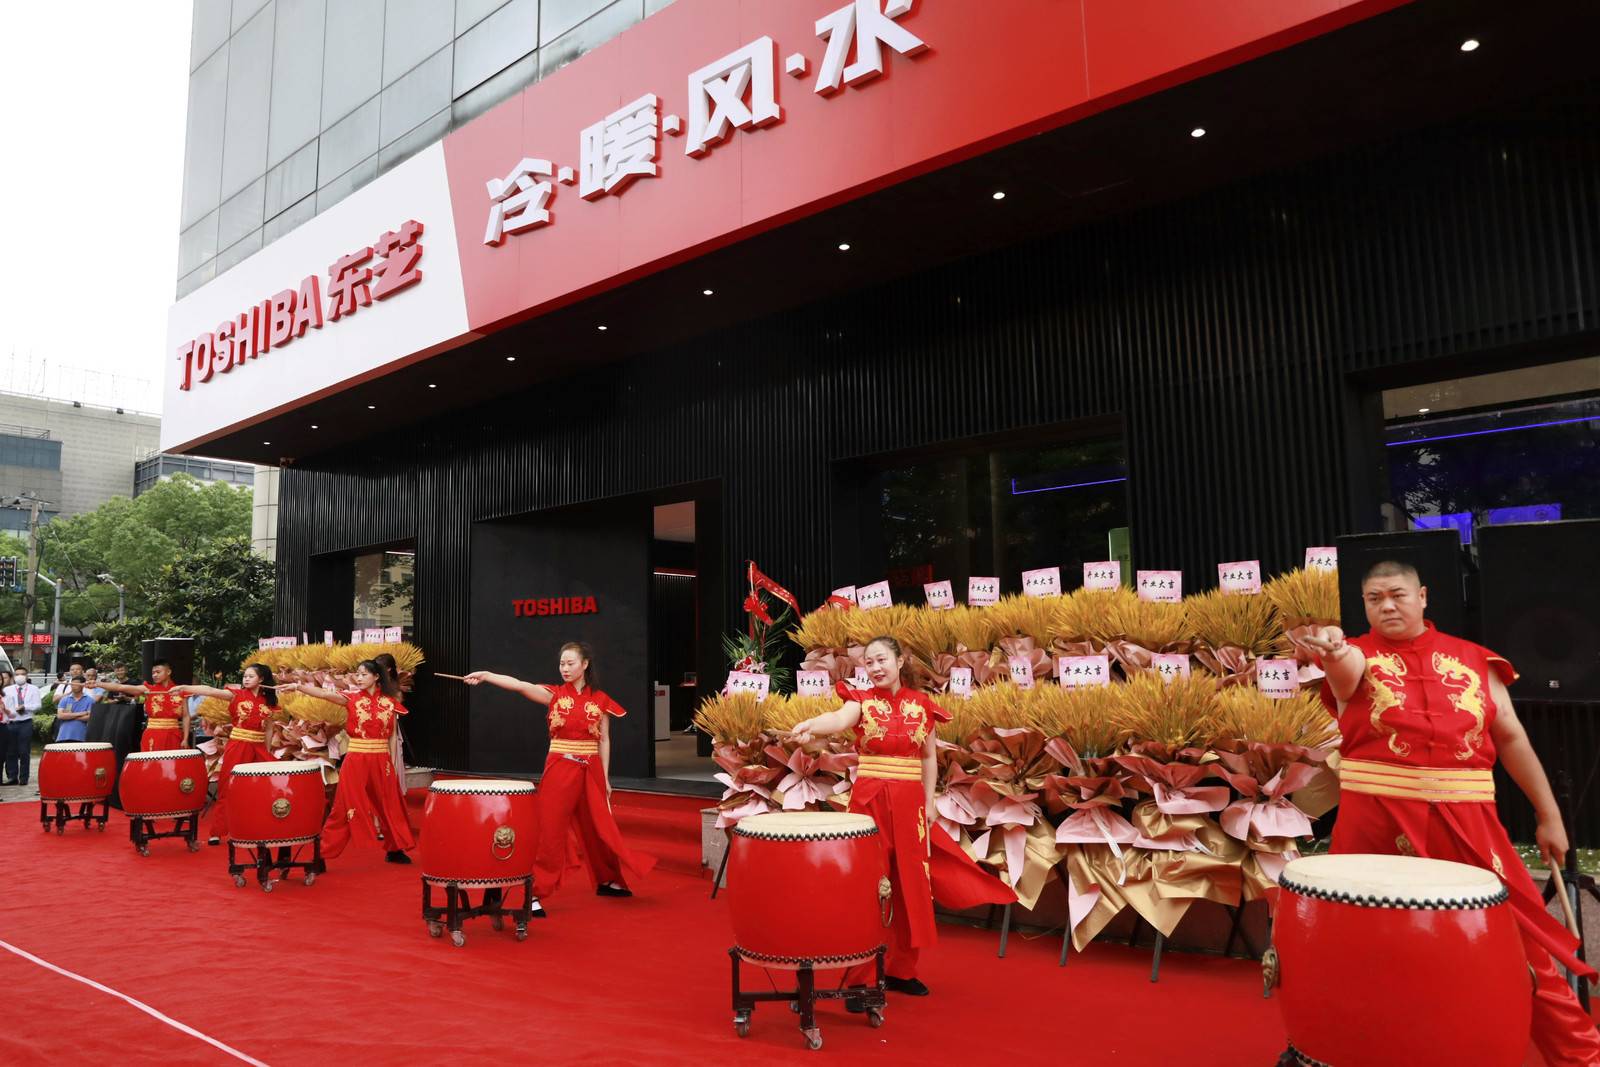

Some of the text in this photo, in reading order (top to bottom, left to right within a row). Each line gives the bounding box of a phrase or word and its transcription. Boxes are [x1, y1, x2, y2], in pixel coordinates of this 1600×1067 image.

[177, 219, 424, 391] TOSHIBA 东芝
[1308, 556, 1338, 567] 开业大
[511, 596, 598, 618] TOSHIBA
[1064, 665, 1102, 677] 开业大吉
